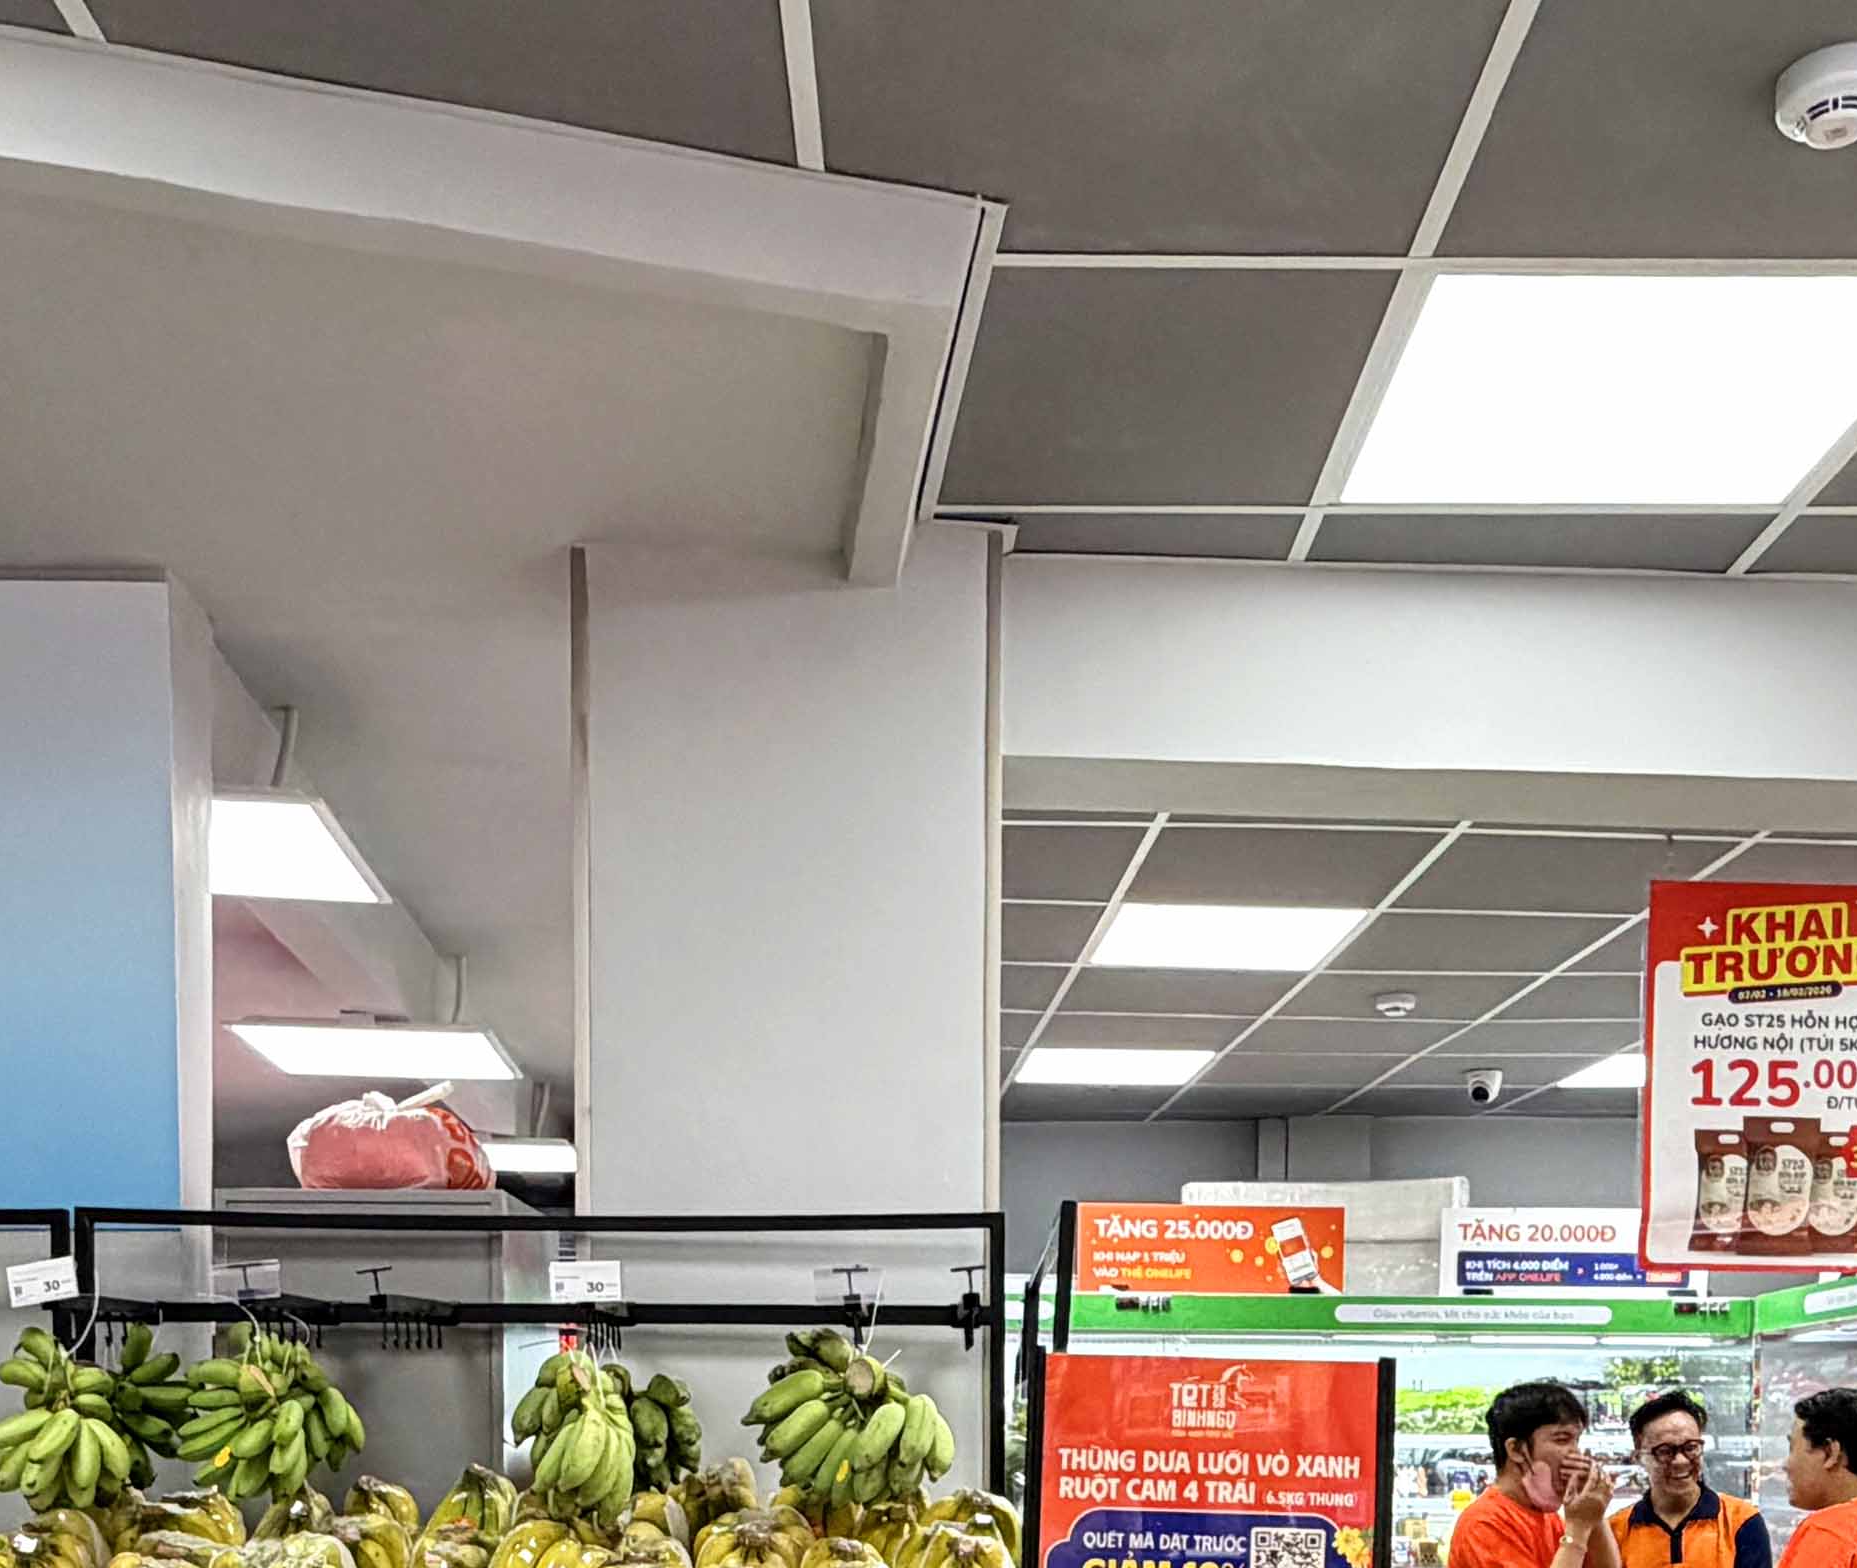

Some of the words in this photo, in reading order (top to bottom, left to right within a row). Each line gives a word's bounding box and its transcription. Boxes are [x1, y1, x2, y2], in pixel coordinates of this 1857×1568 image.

[1732, 907, 1844, 945] KHAI
[1701, 1013, 1740, 1034] GẠO
[1744, 1014, 1786, 1029] ST25
[1790, 1009, 1831, 1029] HỖN
[1694, 1034, 1758, 1051] HƯƠNG
[1762, 1035, 1794, 1053] NỘI
[1799, 1033, 1834, 1055] (TÚI
[1094, 1215, 1158, 1243] TẶNG
[1164, 1219, 1253, 1239] 25.000Đ
[1458, 1219, 1520, 1248] TẶNG
[1528, 1223, 1616, 1243] 20.000Đ
[43, 1279, 61, 1292] 30
[586, 1281, 605, 1293] 30
[1059, 1447, 1137, 1474] THÙNG
[1143, 1450, 1190, 1474] DƯA
[1260, 1449, 1292, 1477] VỎ
[1298, 1454, 1360, 1479] XANH
